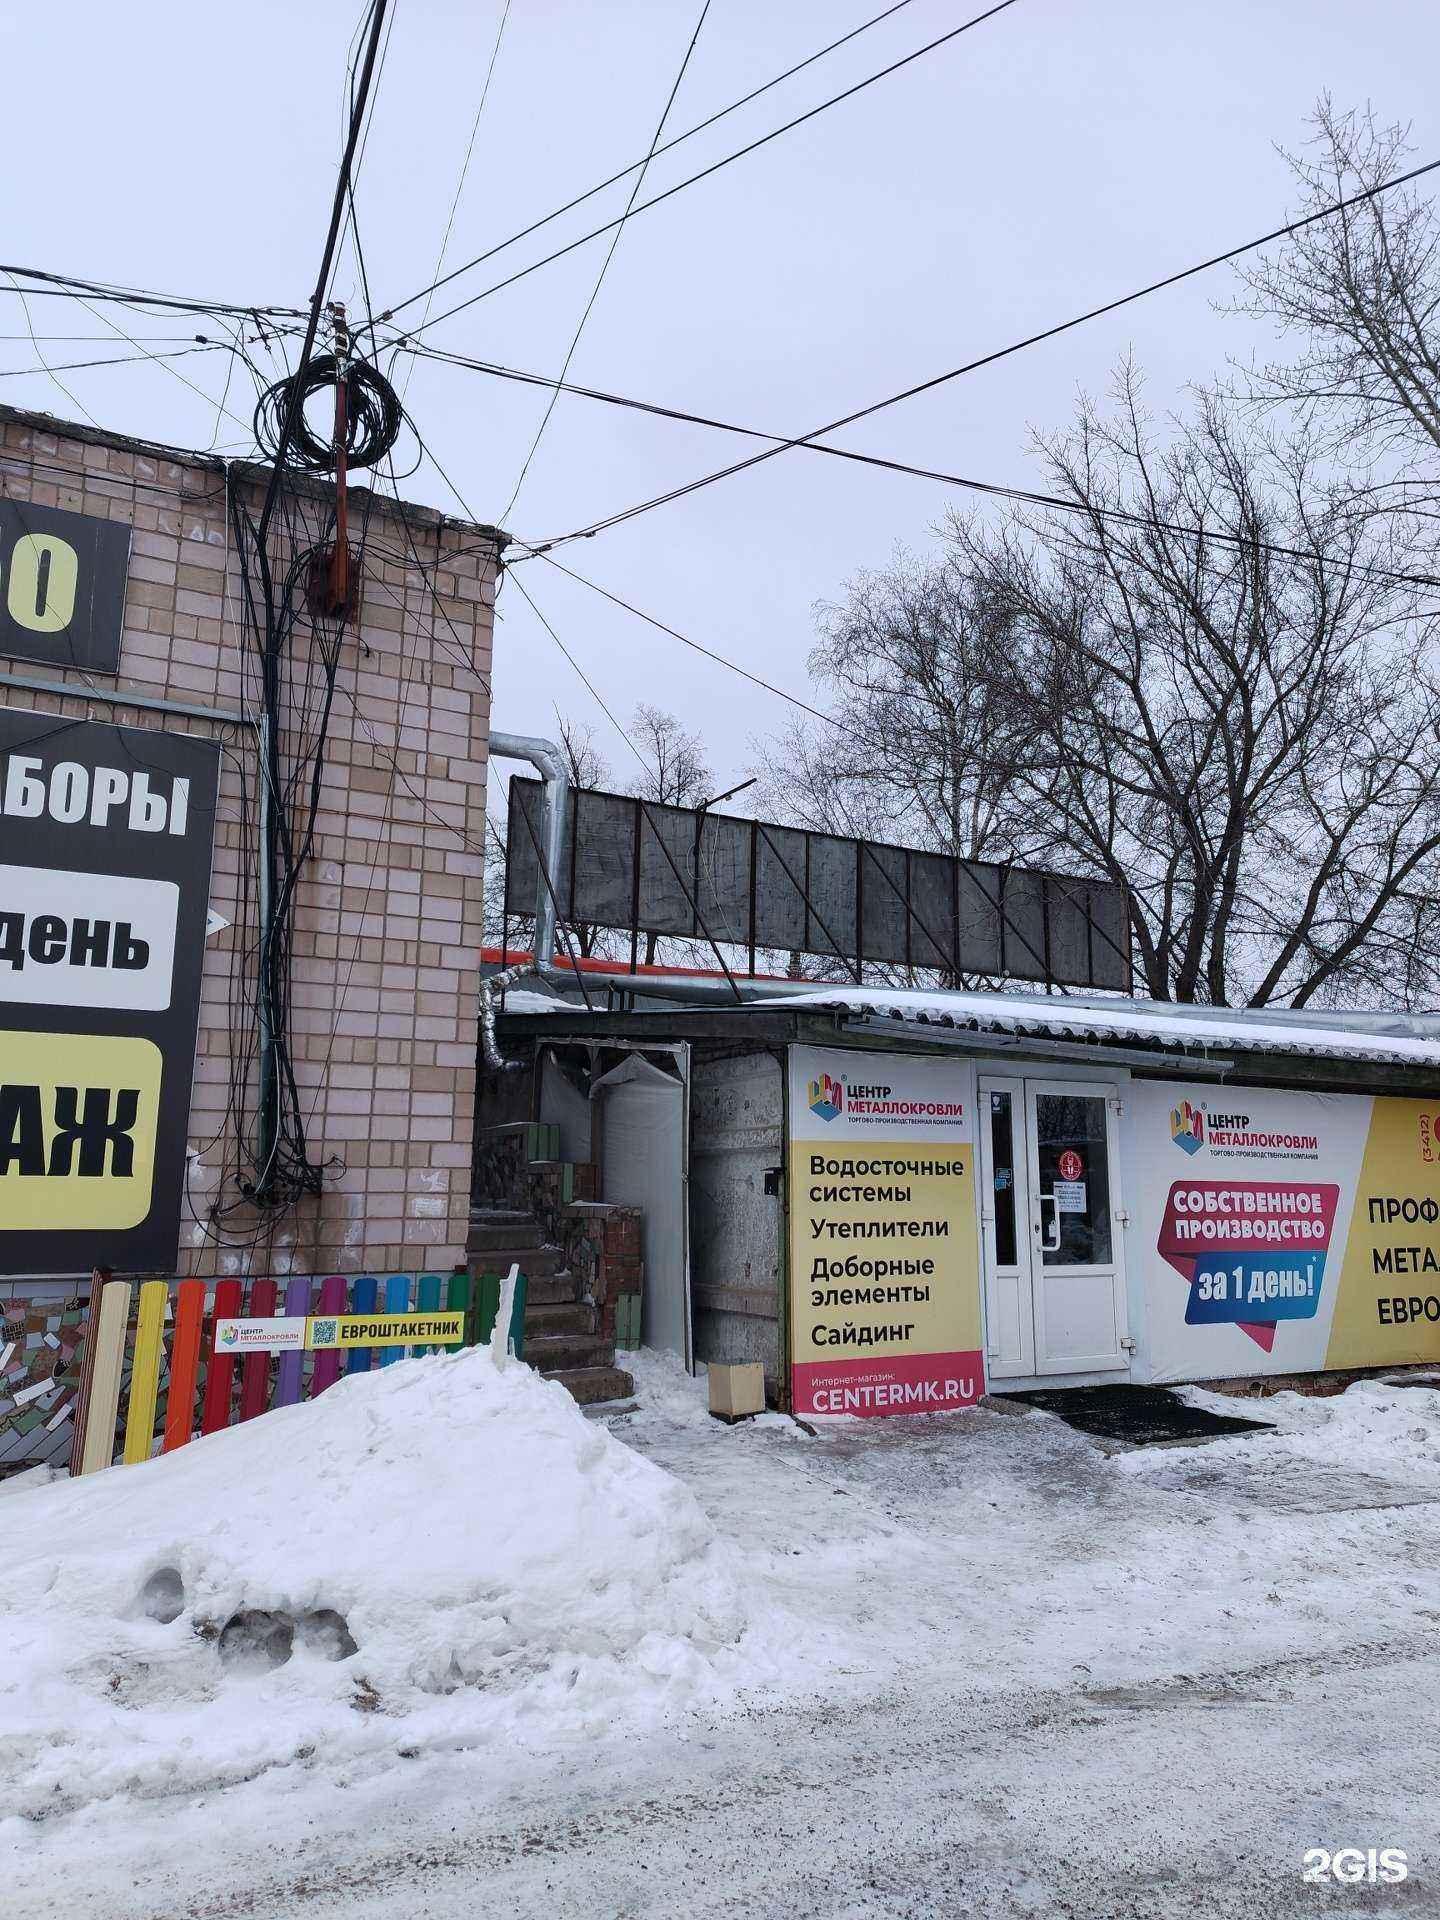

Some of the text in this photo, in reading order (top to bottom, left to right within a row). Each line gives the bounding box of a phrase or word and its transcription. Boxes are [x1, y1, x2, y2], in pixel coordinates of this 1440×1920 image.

[0, 754, 190, 836] БОРЫ
[847, 1085, 892, 1100] ЦЕНТР
[847, 1101, 963, 1116] МЕТАЛЛОКРОВЛИ
[1207, 1113, 1250, 1130] ЦЕНТР
[1208, 1131, 1318, 1149] МЕТАЛЛОКРОВЛИ
[810, 1155, 964, 1178] Водосточные
[809, 1186, 911, 1202] системы
[1173, 1191, 1323, 1214] СОБСТВЕННОЕ
[810, 1219, 949, 1238] Утеплители
[1175, 1219, 1325, 1241] ПРОИЗВОДСТВО
[810, 1255, 935, 1282] Доборные
[1373, 1247, 1440, 1274] МЕТА
[1198, 1274, 1227, 1300] за
[1232, 1266, 1244, 1298] 1
[811, 1286, 930, 1306] элементы
[341, 1321, 459, 1339] ЕВРОШТАКЕТНИК
[811, 1322, 915, 1346] Сайдинг
[811, 1373, 896, 1386] Интернет-магазин:
[812, 1379, 975, 1412] CENTERMK.RU
